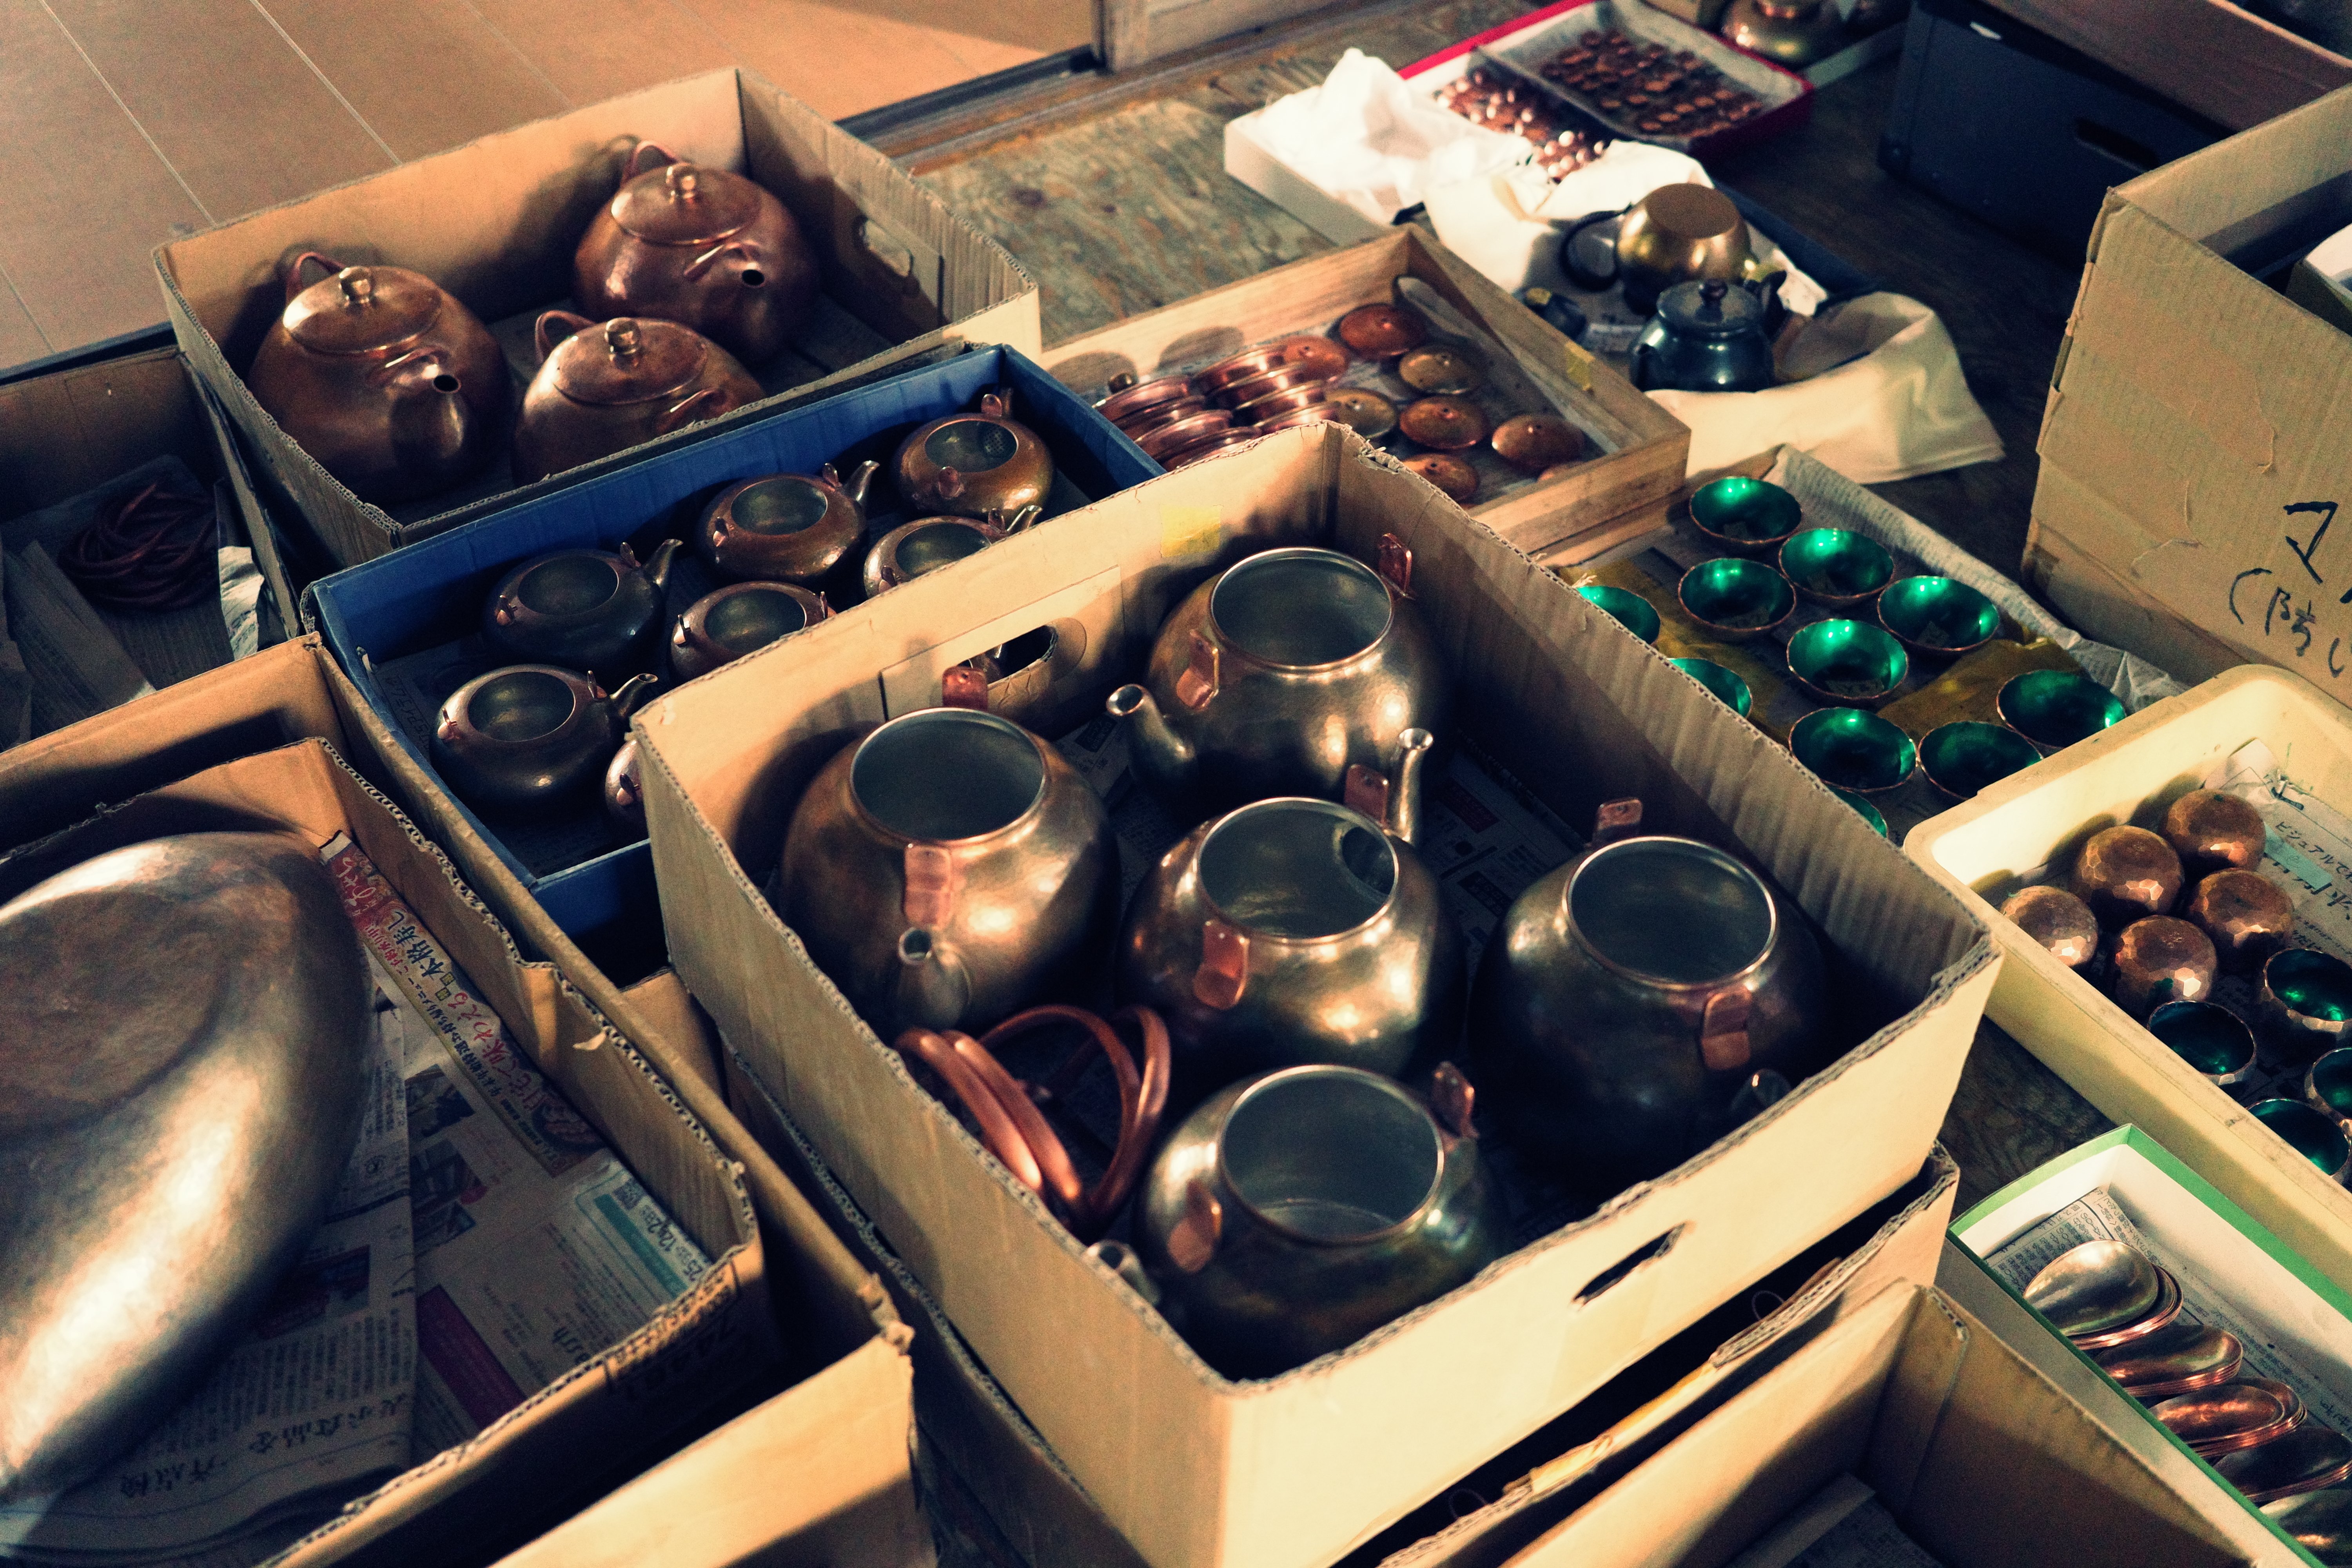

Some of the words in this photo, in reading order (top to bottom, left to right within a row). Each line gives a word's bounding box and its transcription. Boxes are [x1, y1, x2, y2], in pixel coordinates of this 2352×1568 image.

[2283, 501, 2352, 604] マ
[388, 911, 445, 977] 本格寿し
